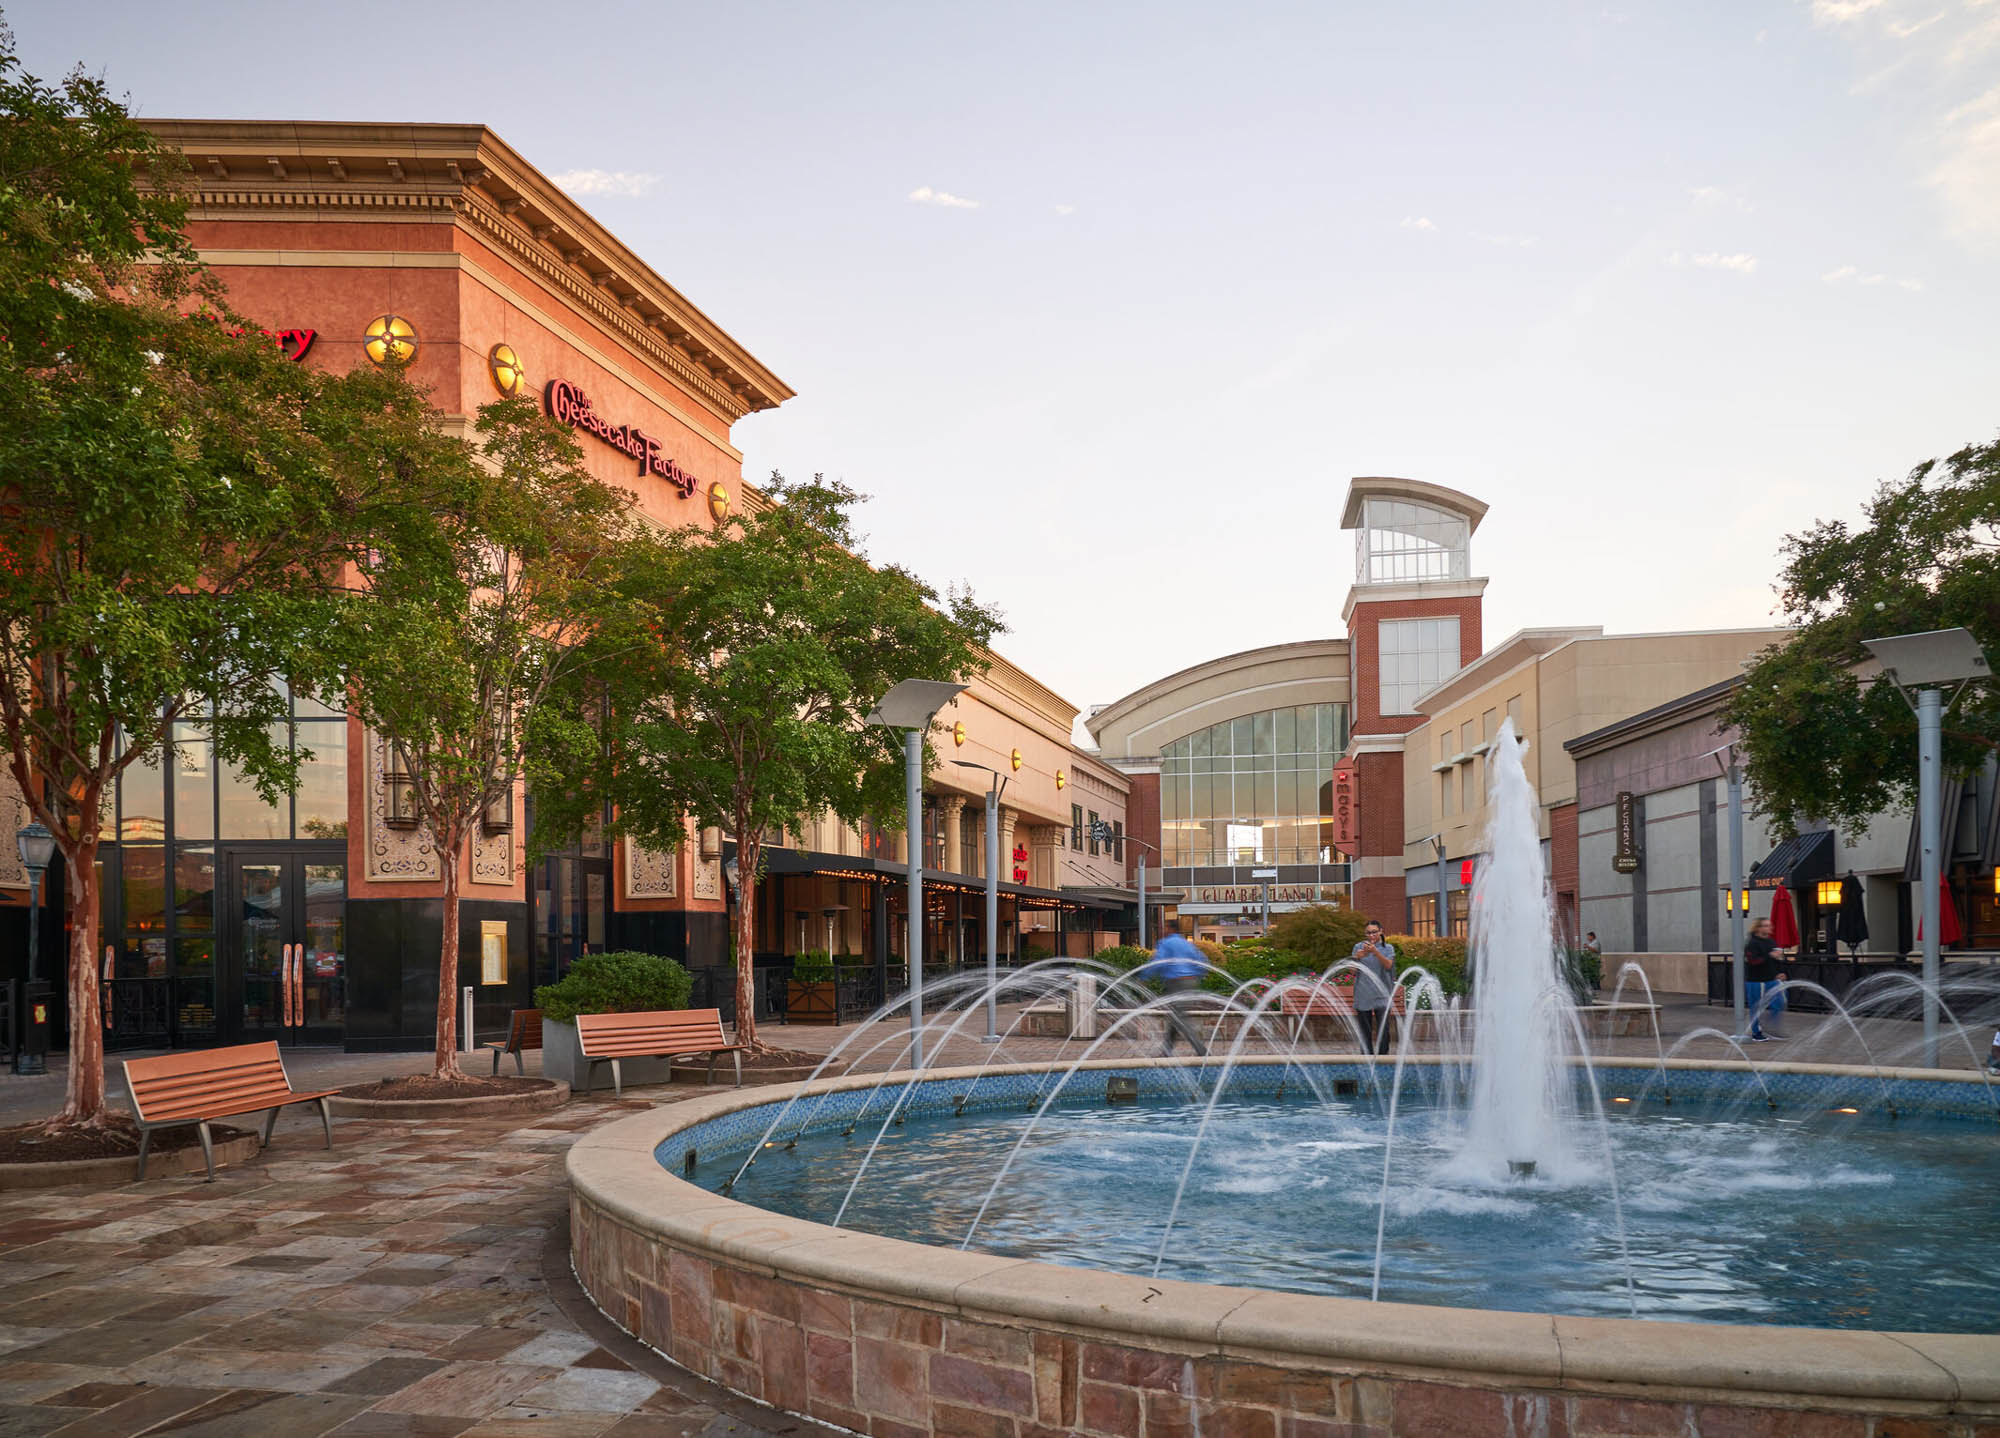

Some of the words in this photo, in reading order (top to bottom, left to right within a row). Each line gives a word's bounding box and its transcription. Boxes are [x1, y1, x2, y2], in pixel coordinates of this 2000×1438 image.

[573, 386, 592, 409] The
[545, 378, 644, 461] Cheesecake
[637, 428, 699, 499] Factory
[1755, 879, 1770, 888] TAKE
[1203, 887, 1315, 904] CUMBELAND
